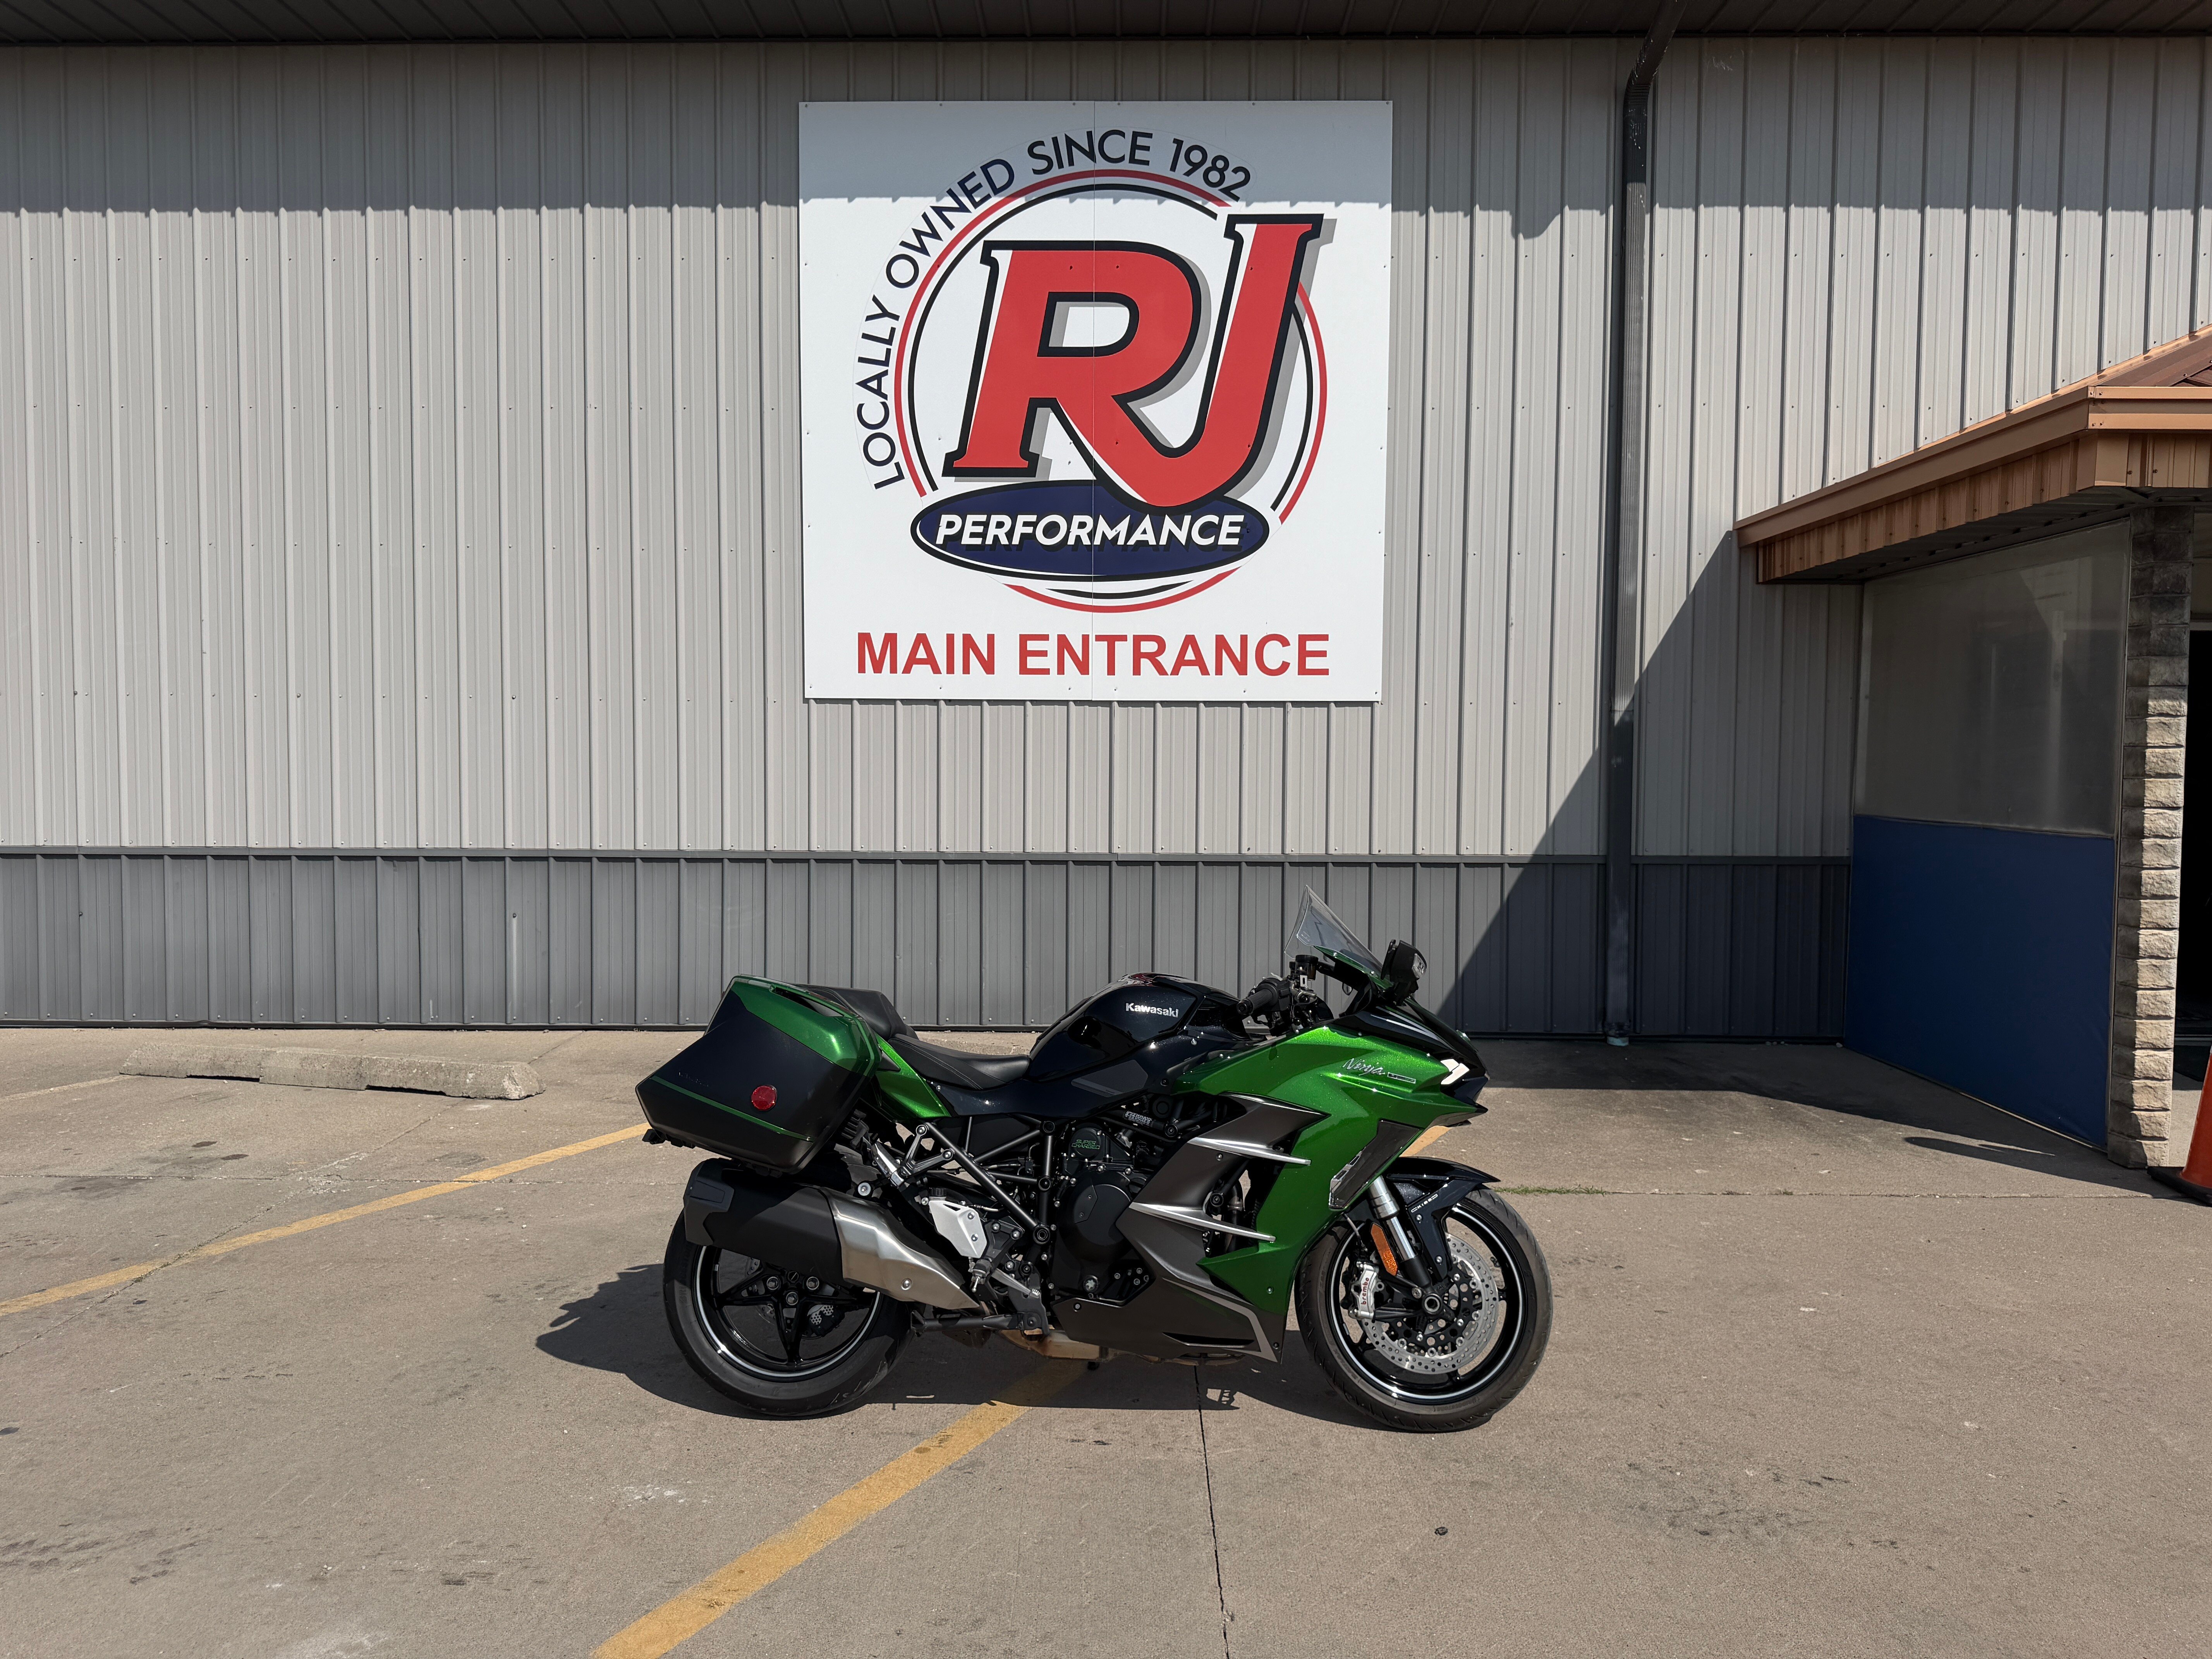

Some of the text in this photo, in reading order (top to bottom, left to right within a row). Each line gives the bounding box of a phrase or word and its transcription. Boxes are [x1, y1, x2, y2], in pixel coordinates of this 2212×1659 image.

[856, 130, 1250, 489] LOCALLY OWNED SINCE 1982
[942, 214, 1324, 514] RJ
[936, 514, 1244, 545] PERFORMANCE
[858, 633, 1329, 676] MAIN ENTRANCE
[1126, 1003, 1179, 1017] Kawasaki
[1342, 1058, 1385, 1076] Ninja
[1360, 1278, 1369, 1305] brembo
